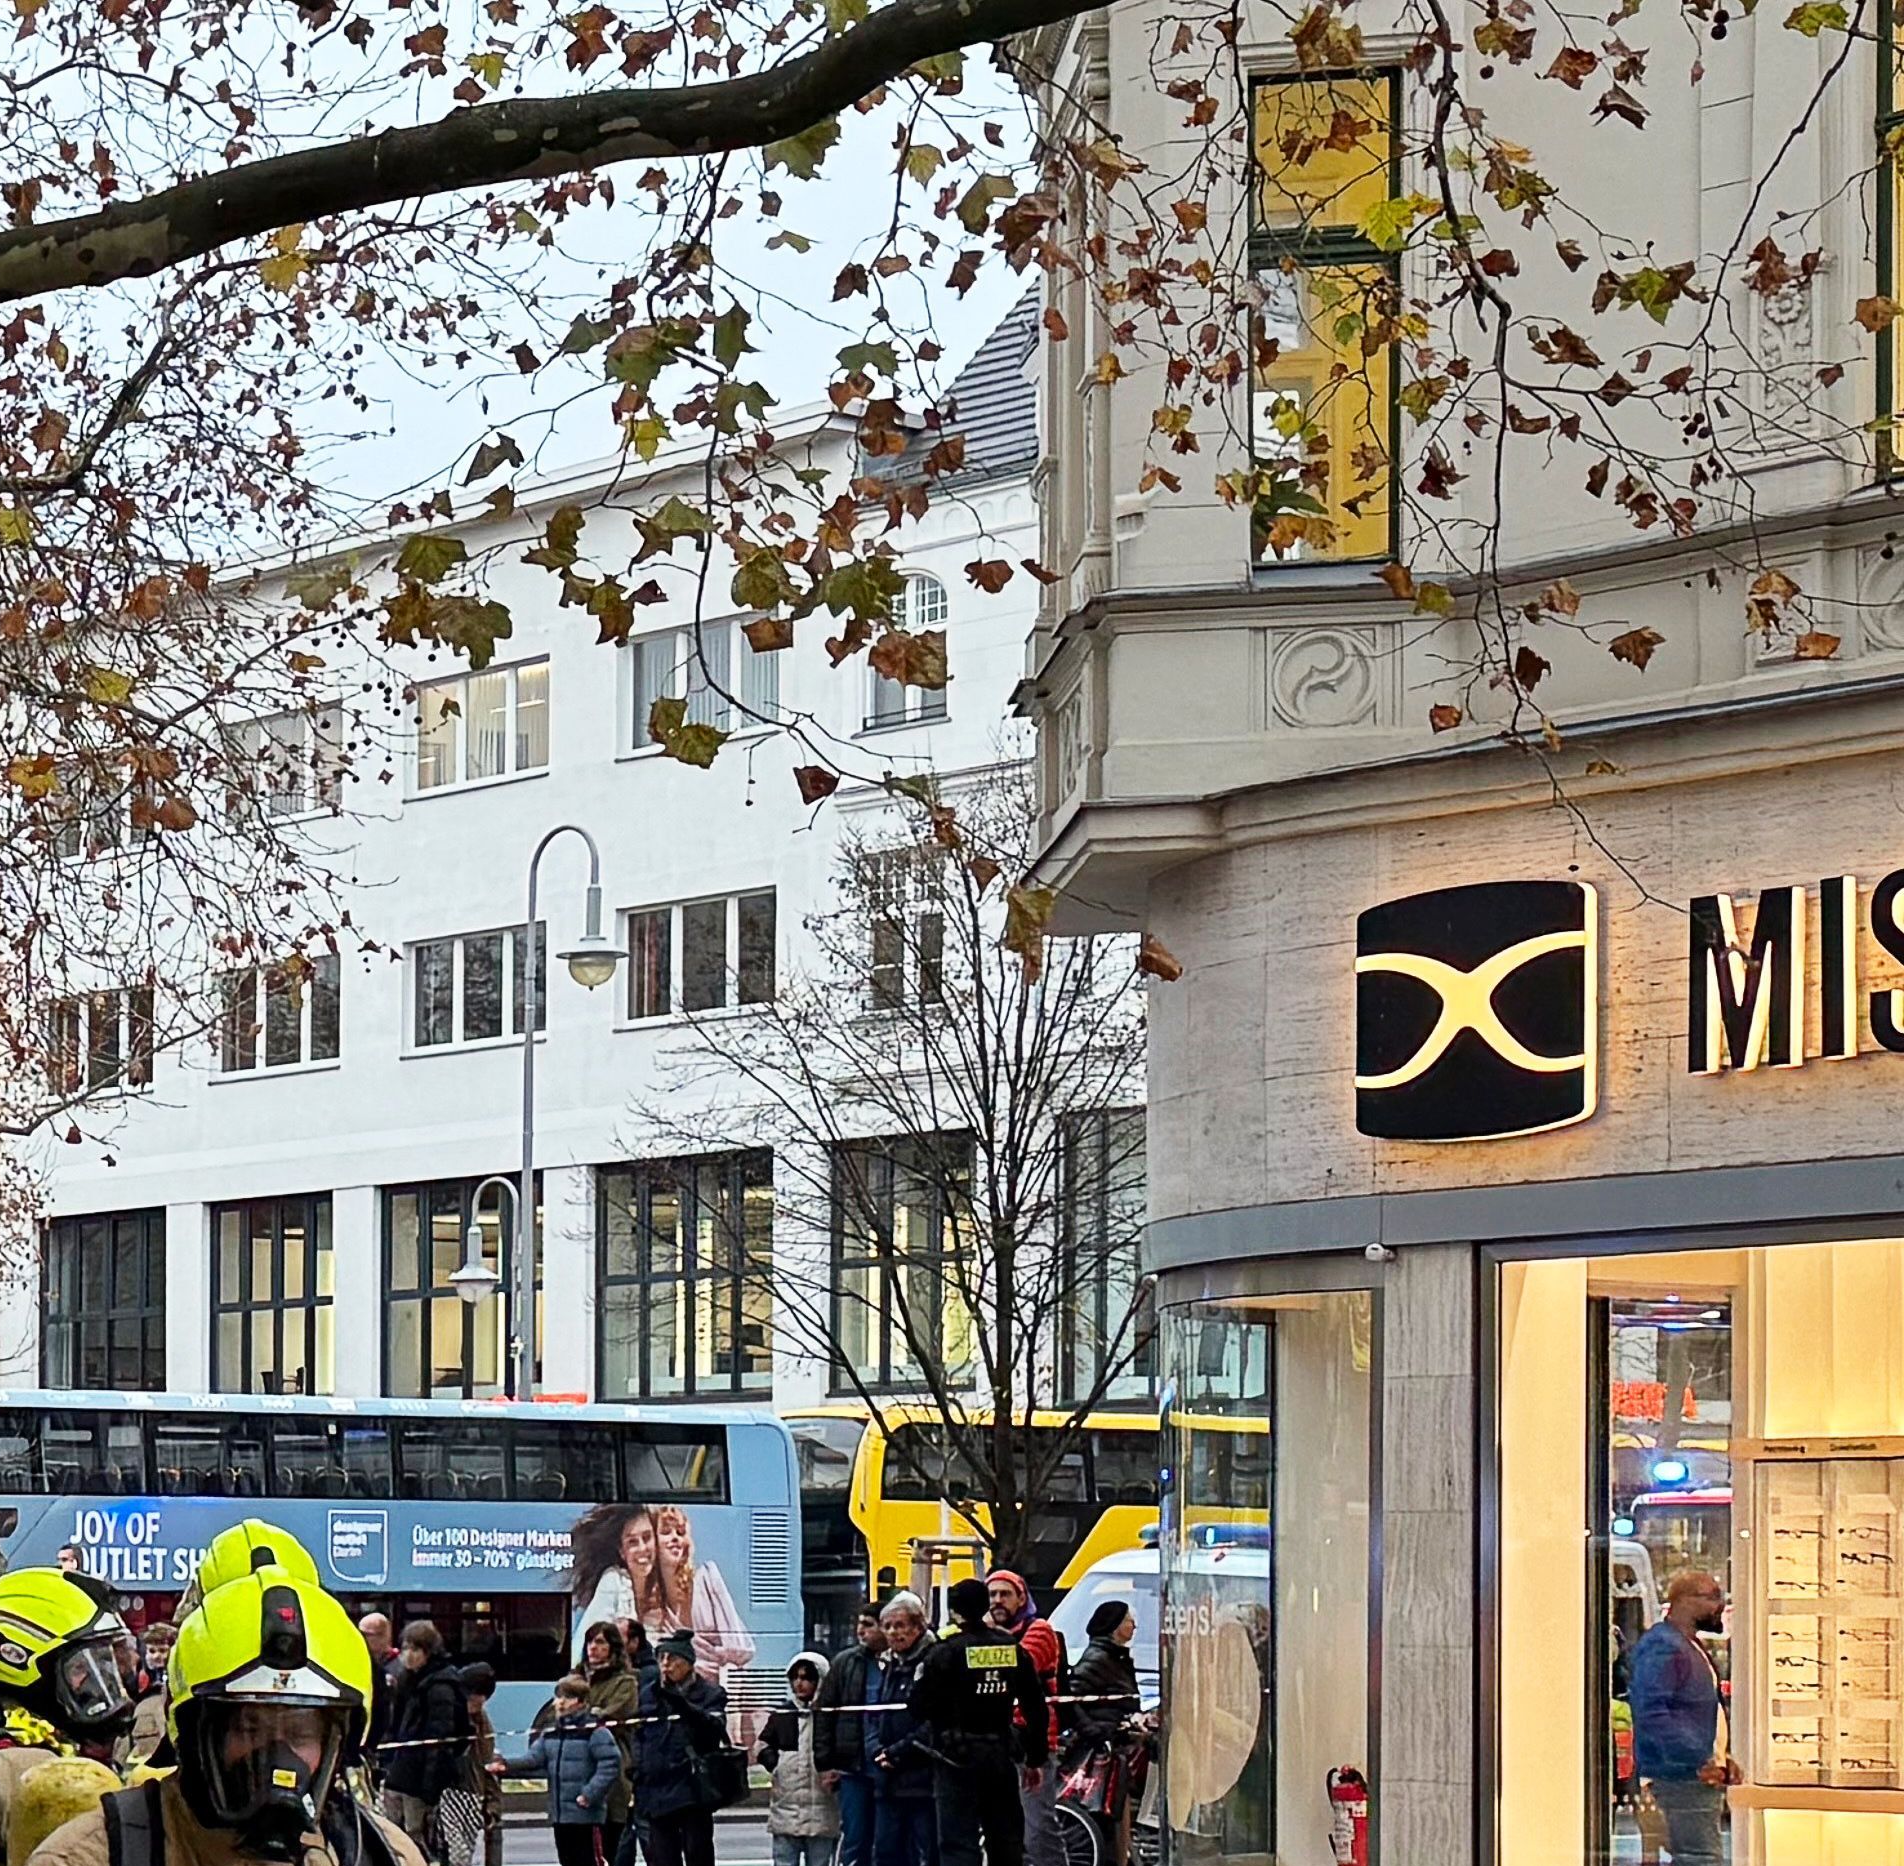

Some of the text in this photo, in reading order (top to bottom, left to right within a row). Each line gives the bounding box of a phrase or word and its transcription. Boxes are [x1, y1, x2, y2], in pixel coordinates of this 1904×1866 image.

[69, 1510, 161, 1545] JOY OF
[445, 1529, 467, 1547] 100
[470, 1530, 525, 1549] Designer
[527, 1531, 572, 1548] Marken
